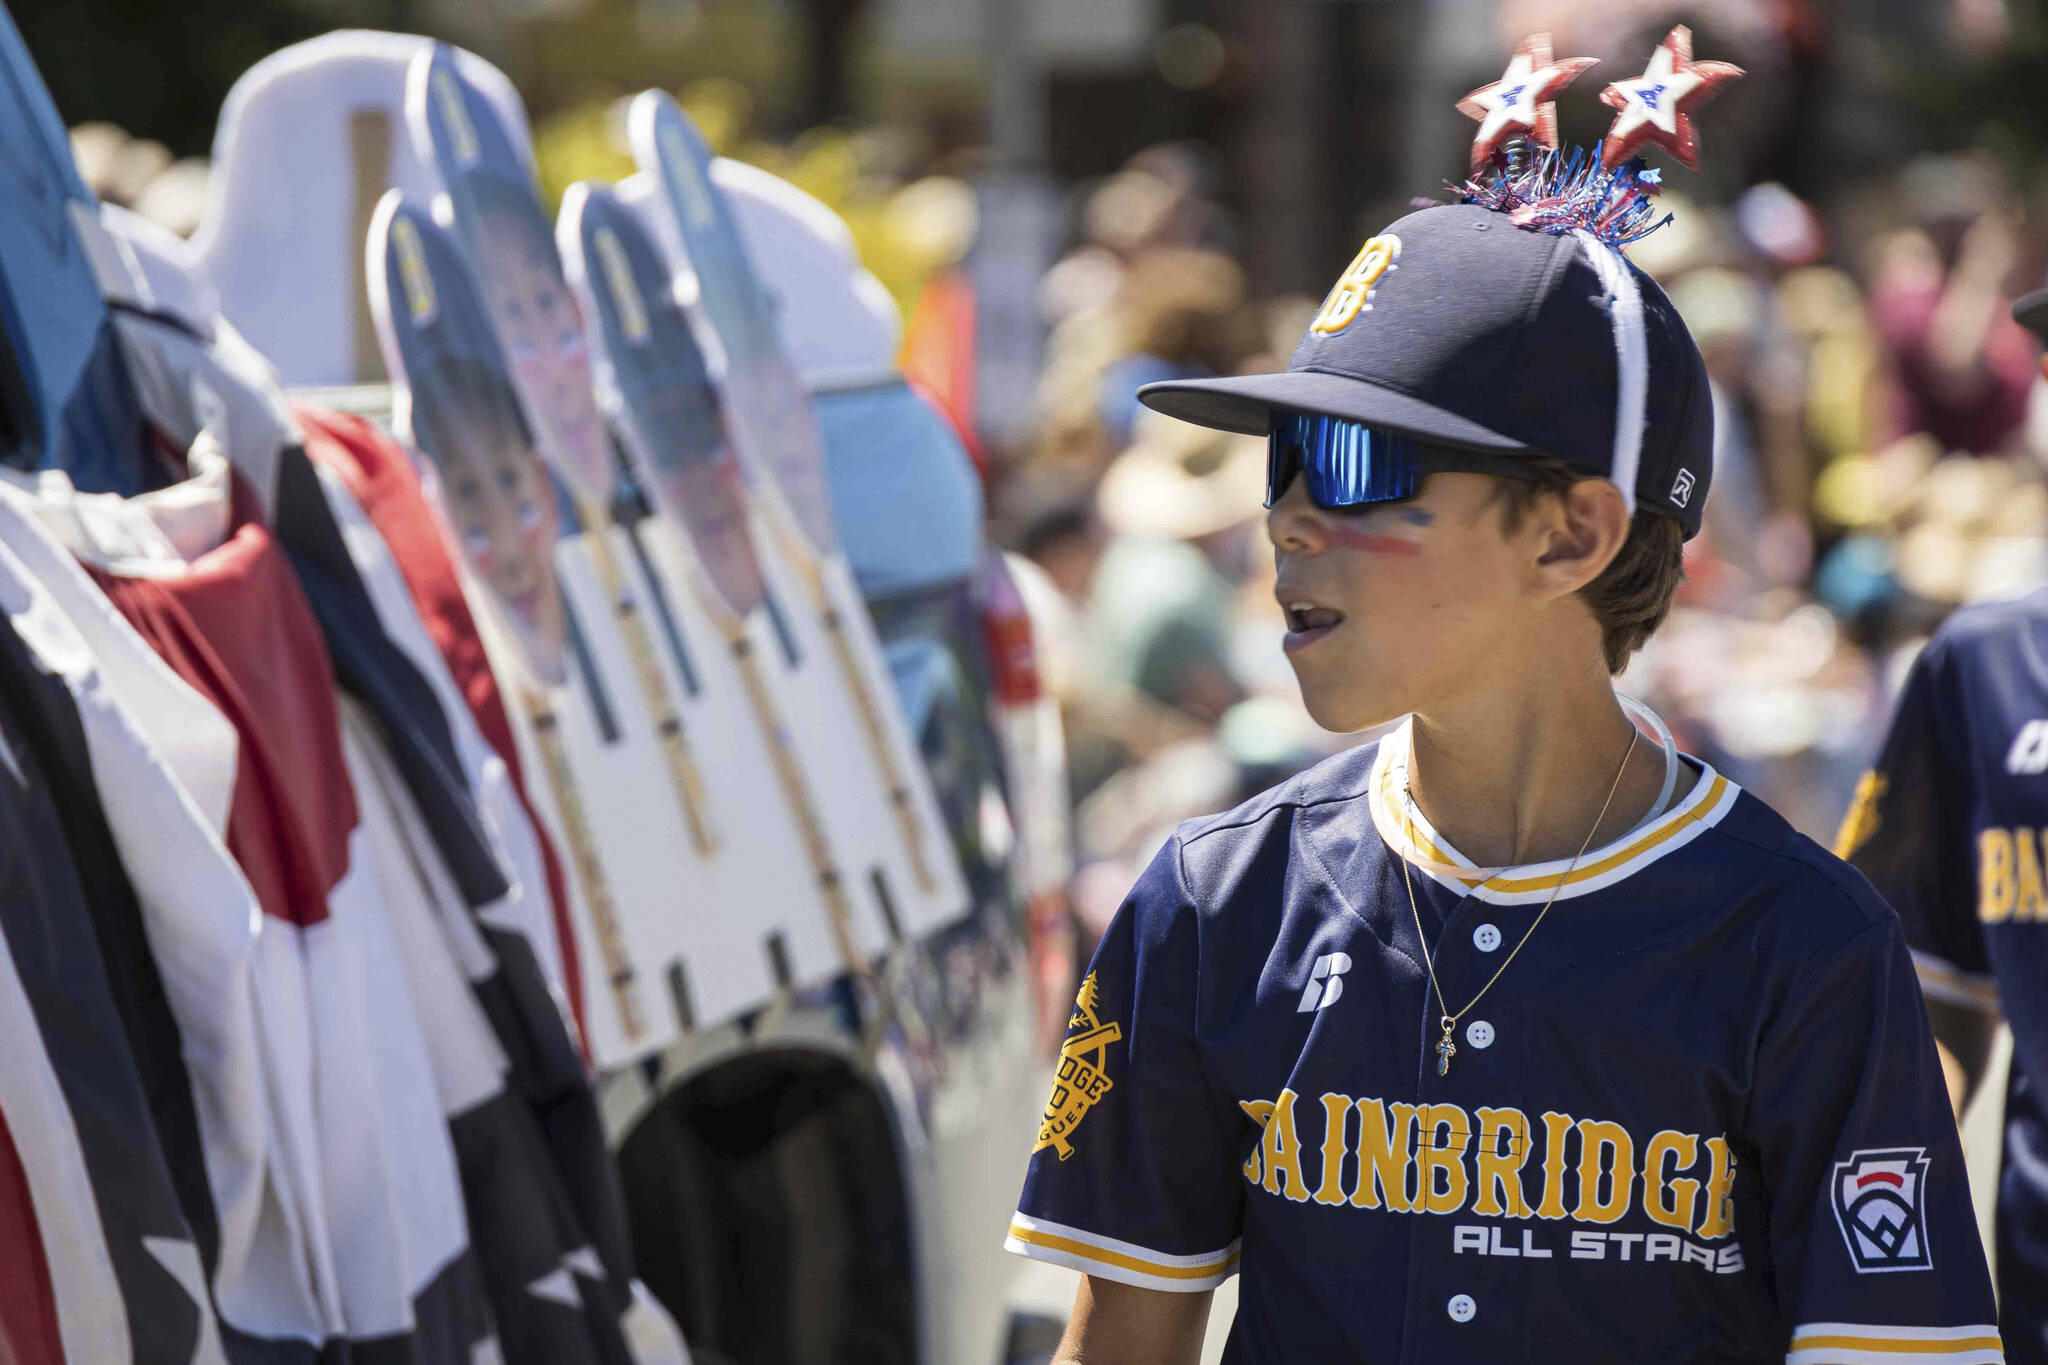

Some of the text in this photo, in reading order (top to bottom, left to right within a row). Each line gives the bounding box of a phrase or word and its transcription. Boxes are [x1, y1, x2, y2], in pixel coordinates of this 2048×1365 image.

[1309, 233, 1401, 338] B
[1453, 1225, 1746, 1274] ALL STARS
